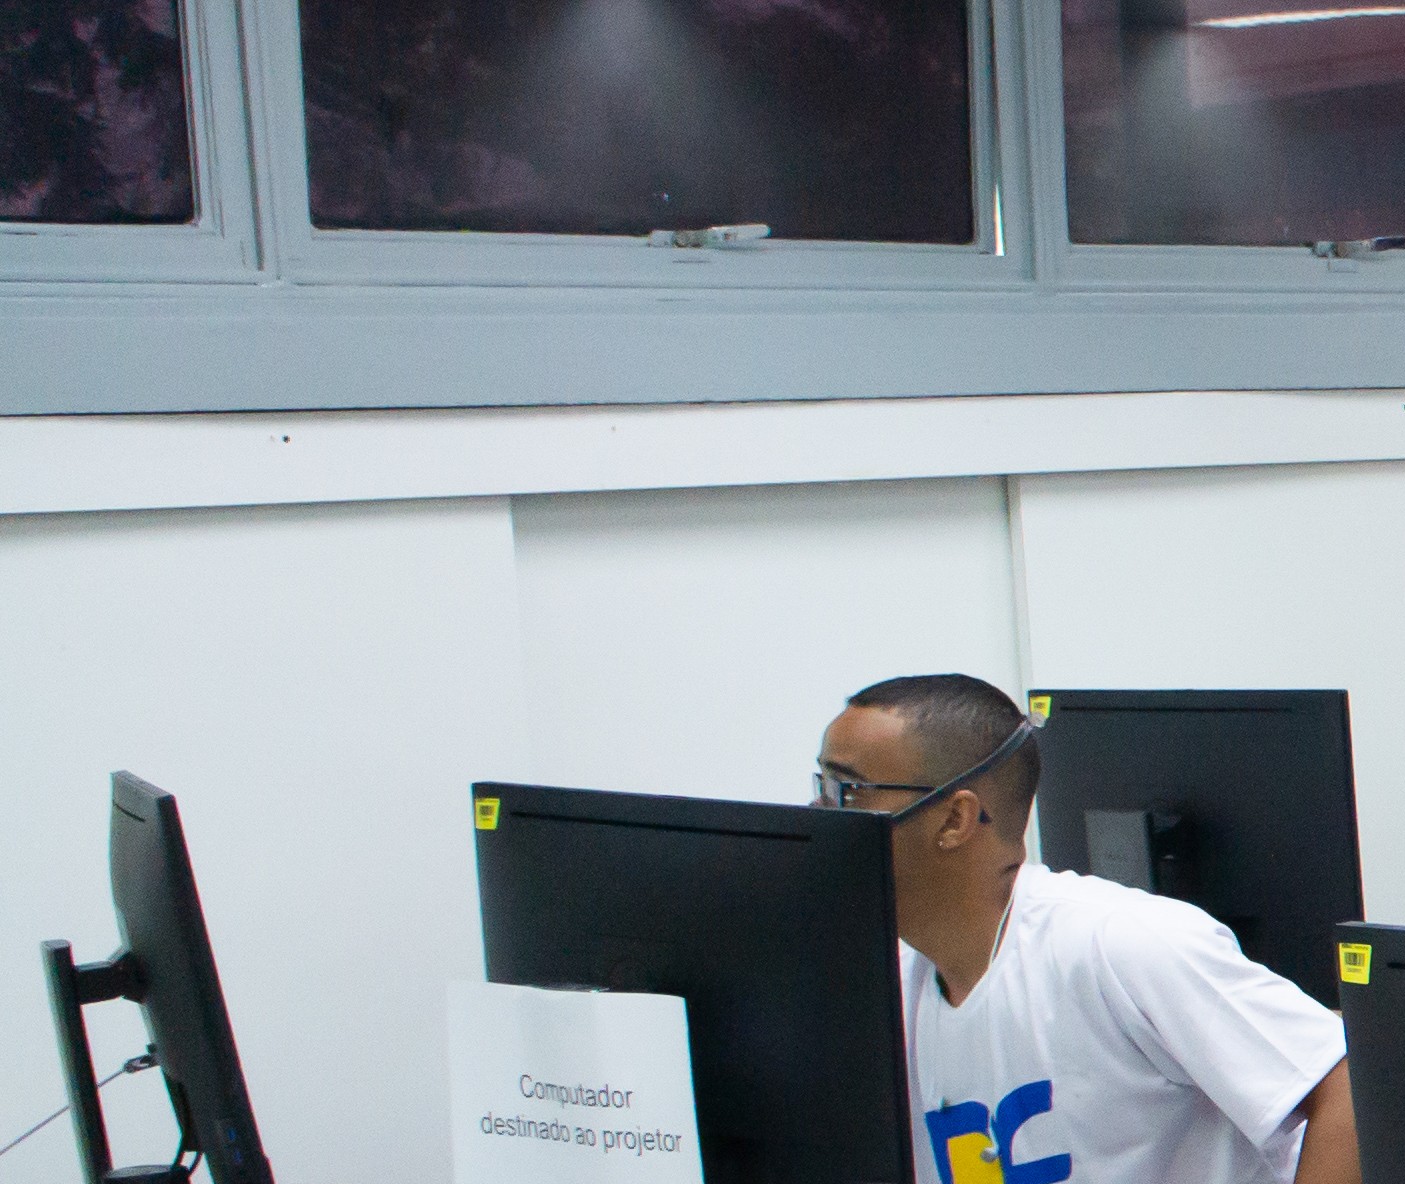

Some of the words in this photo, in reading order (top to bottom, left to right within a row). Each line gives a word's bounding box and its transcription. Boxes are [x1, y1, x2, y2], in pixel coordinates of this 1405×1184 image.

[518, 1073, 634, 1110] Computador
[479, 1111, 571, 1144] destinado
[574, 1125, 597, 1148] ao
[602, 1125, 682, 1157] projetor
